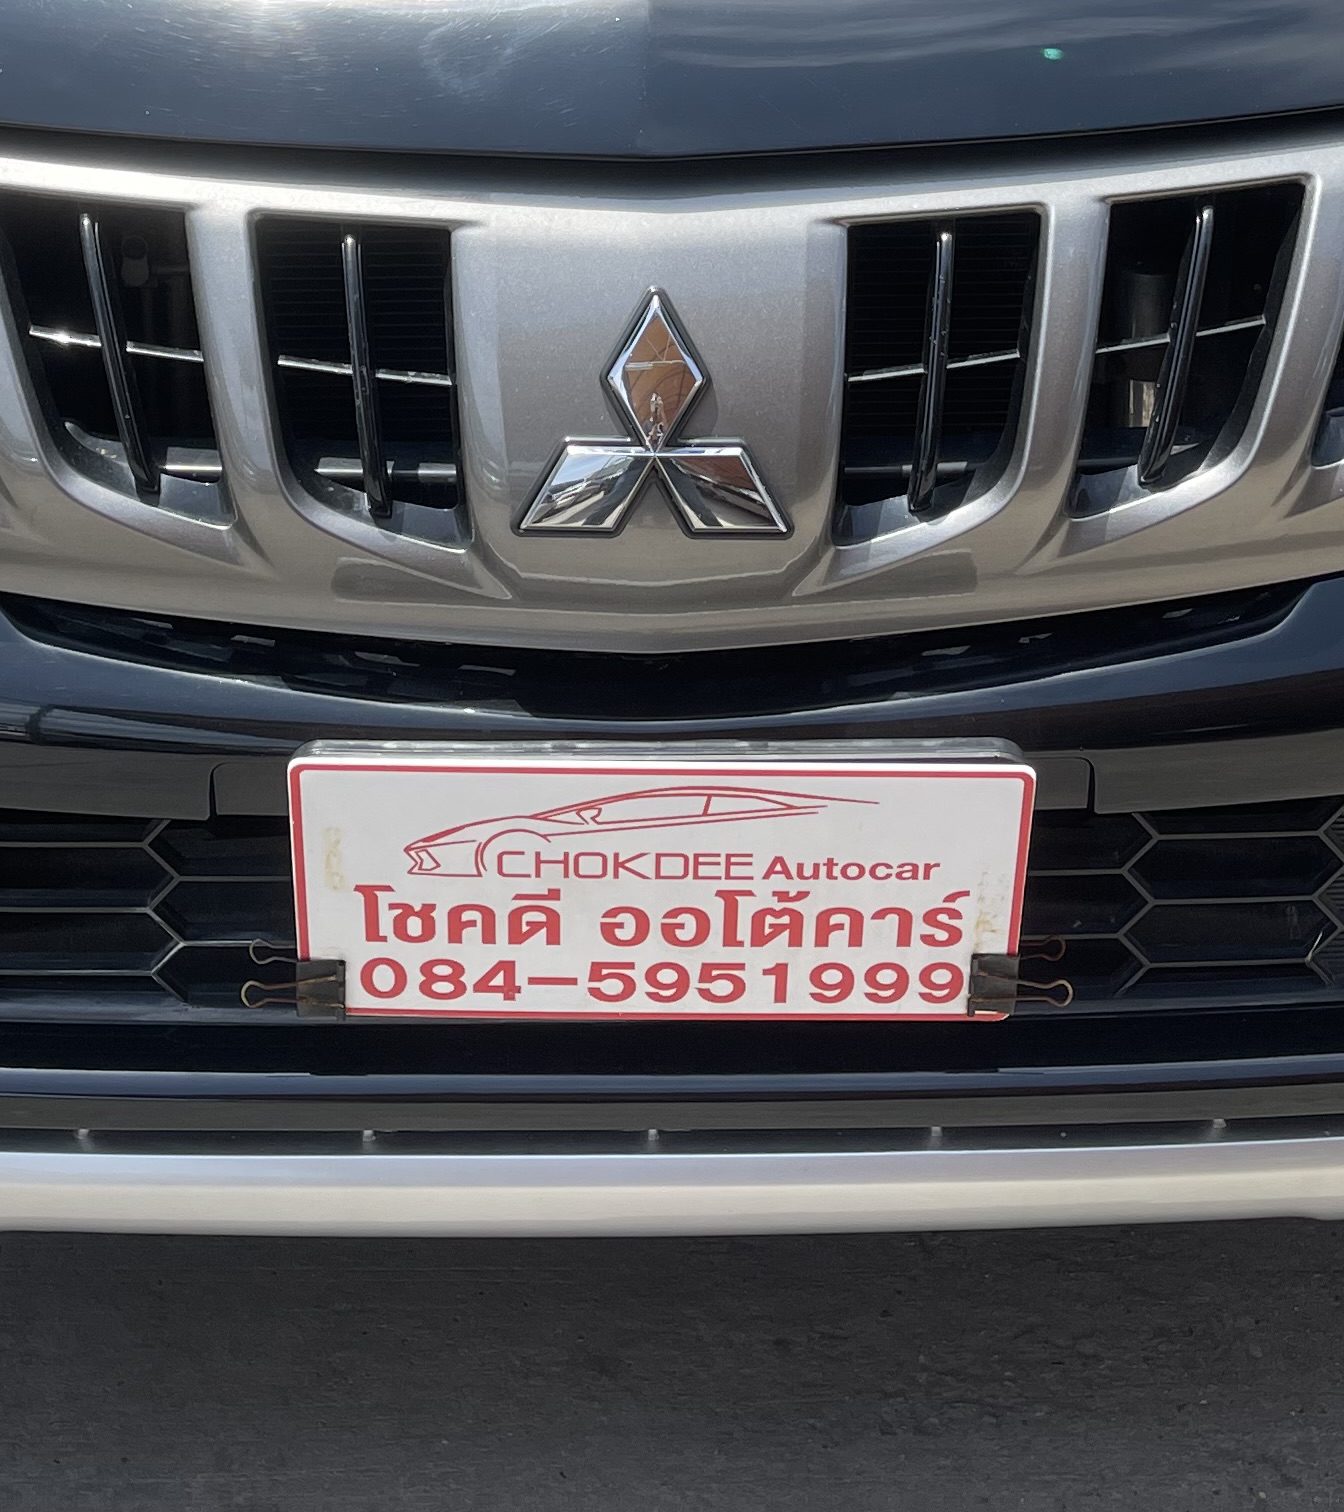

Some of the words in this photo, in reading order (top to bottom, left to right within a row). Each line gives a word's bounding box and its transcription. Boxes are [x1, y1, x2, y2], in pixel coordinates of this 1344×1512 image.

[496, 849, 755, 881] CHOKDEE
[762, 856, 941, 881] Autocar
[353, 883, 561, 948] โชคดี
[599, 889, 971, 948] ออโต้คาร์
[359, 958, 965, 1005] 084-5951999
